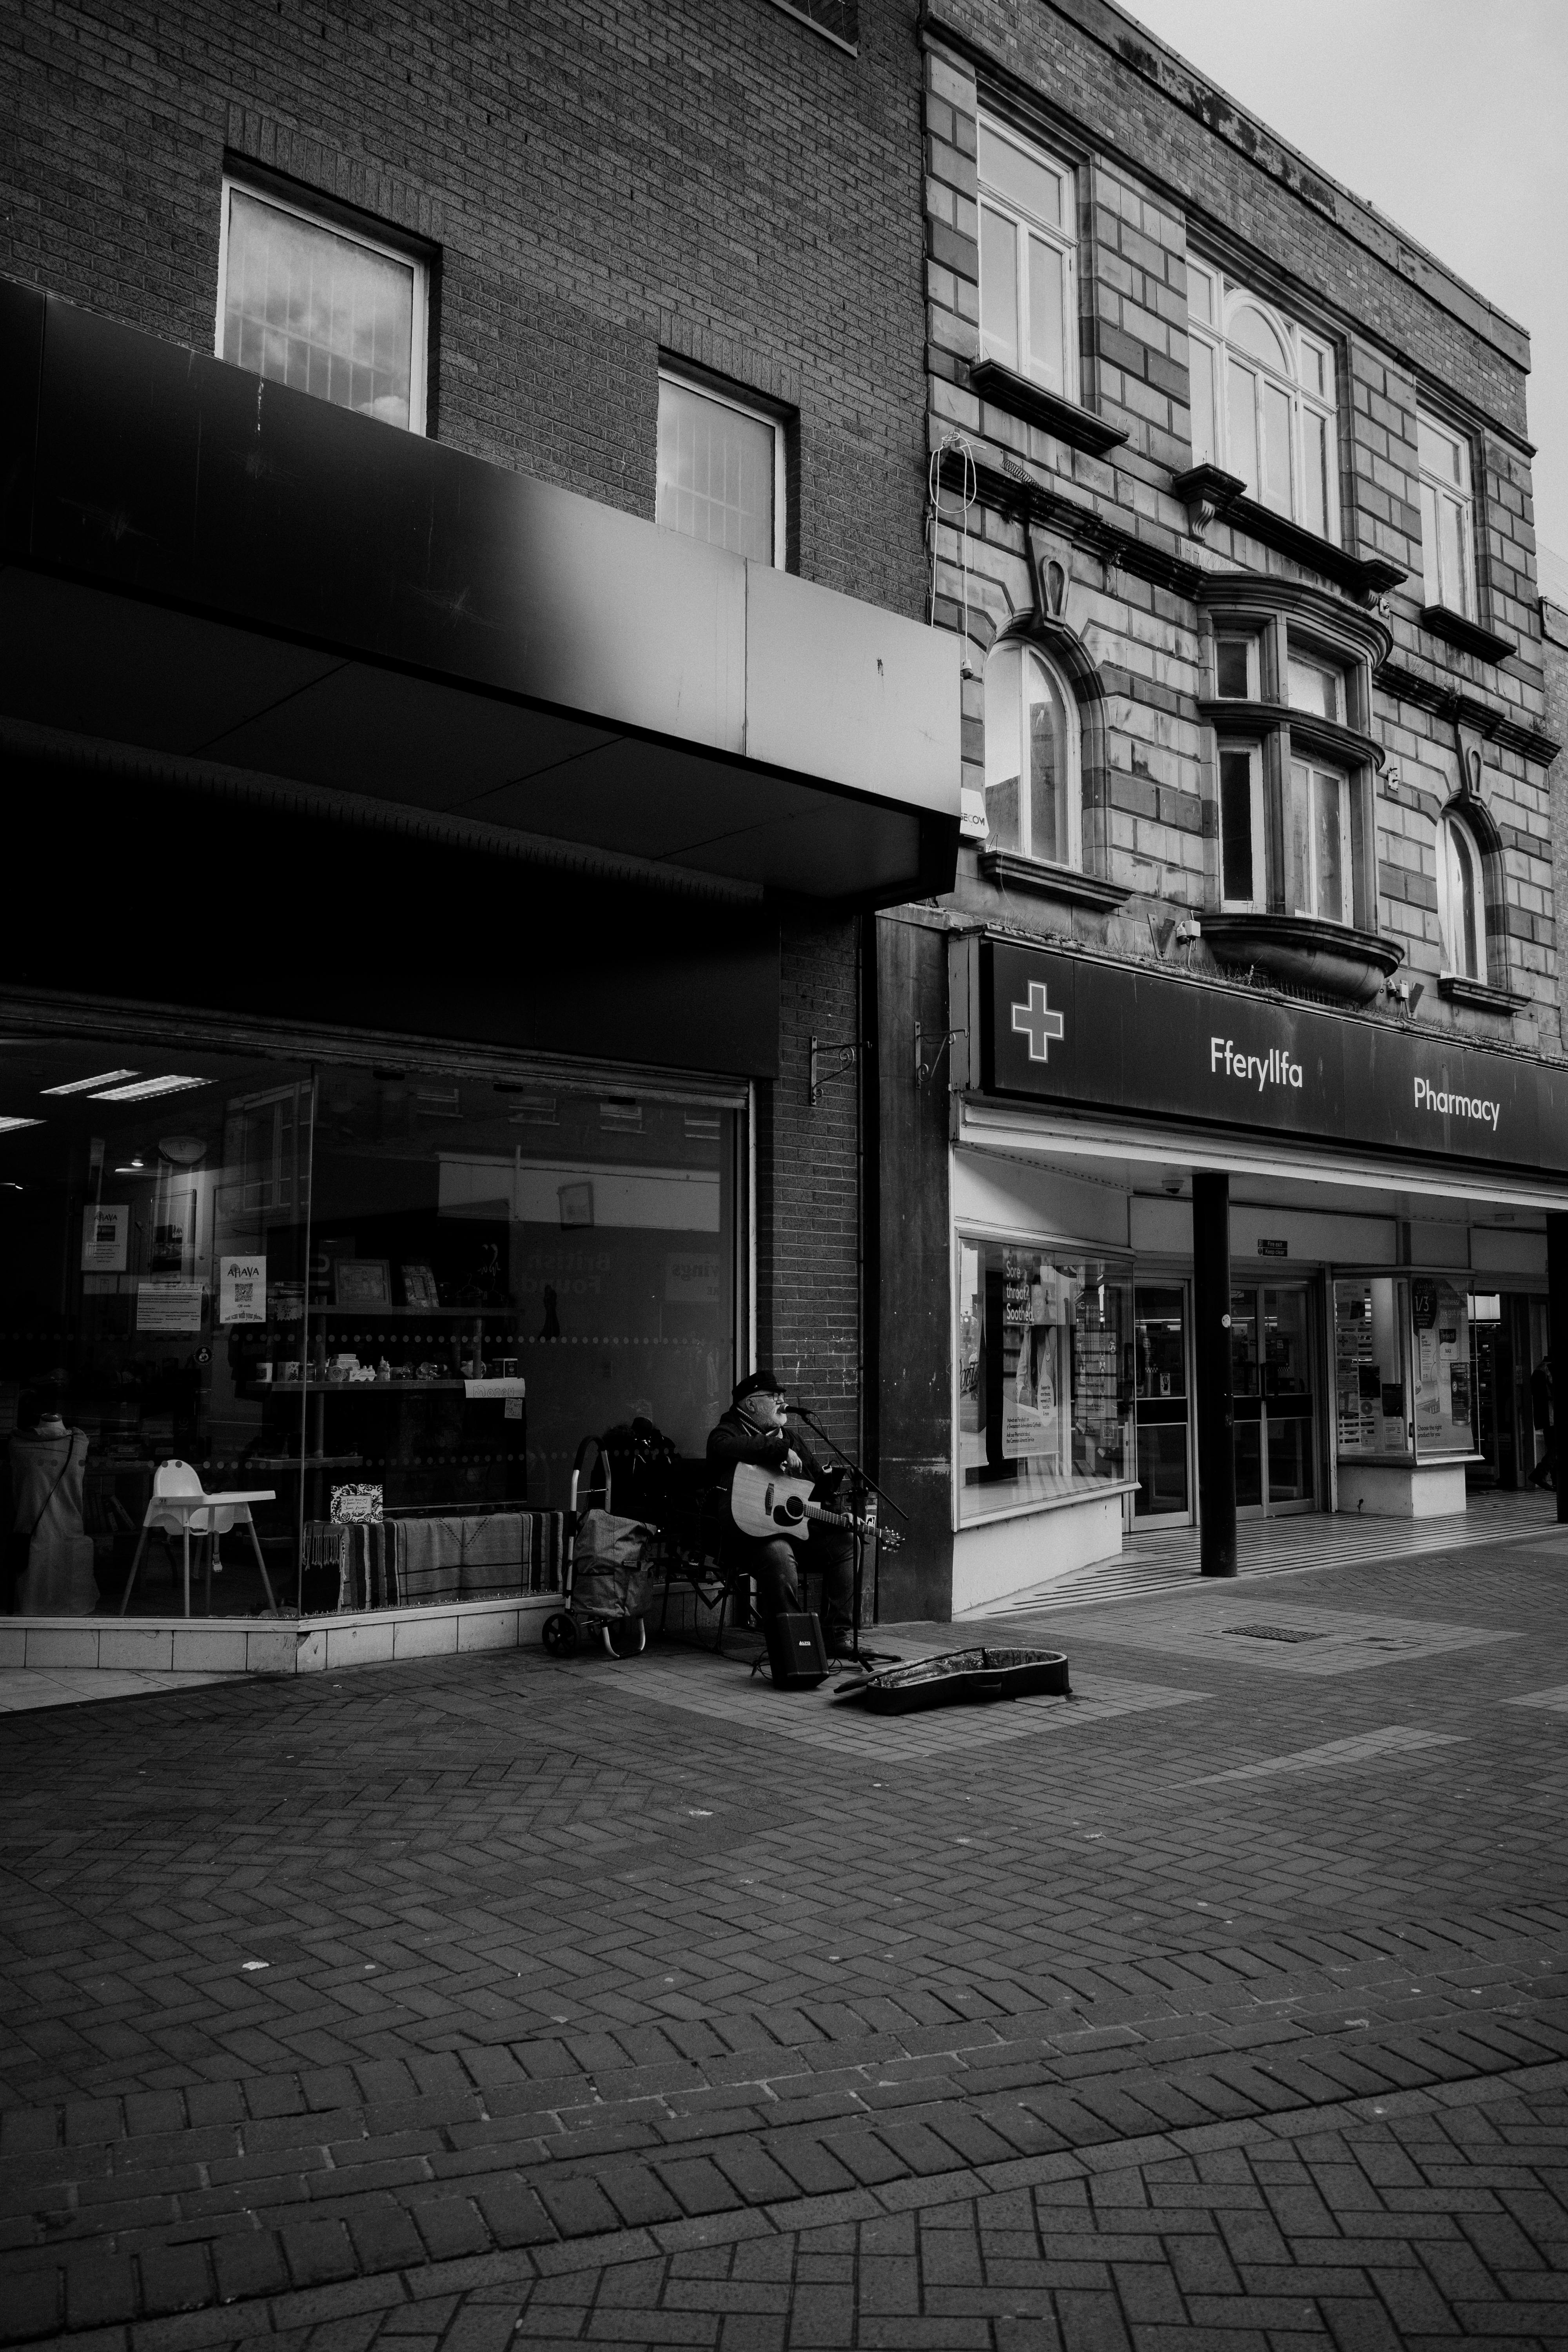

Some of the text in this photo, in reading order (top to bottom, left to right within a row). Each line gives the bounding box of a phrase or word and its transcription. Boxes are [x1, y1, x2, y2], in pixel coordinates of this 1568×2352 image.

[1211, 1037, 1302, 1092] Fferyllfa
[1414, 1077, 1500, 1131] Pharmacy
[1265, 1247, 1274, 1255] Keep
[227, 1267, 259, 1278] AHAVA
[1006, 1260, 1020, 1279] Sore
[1007, 1282, 1029, 1300] throat?
[1007, 1303, 1034, 1322] Soothed.
[1415, 1296, 1429, 1312] 1/3
[1440, 1330, 1455, 1340] Perfectil
[473, 1385, 514, 1398] Money
